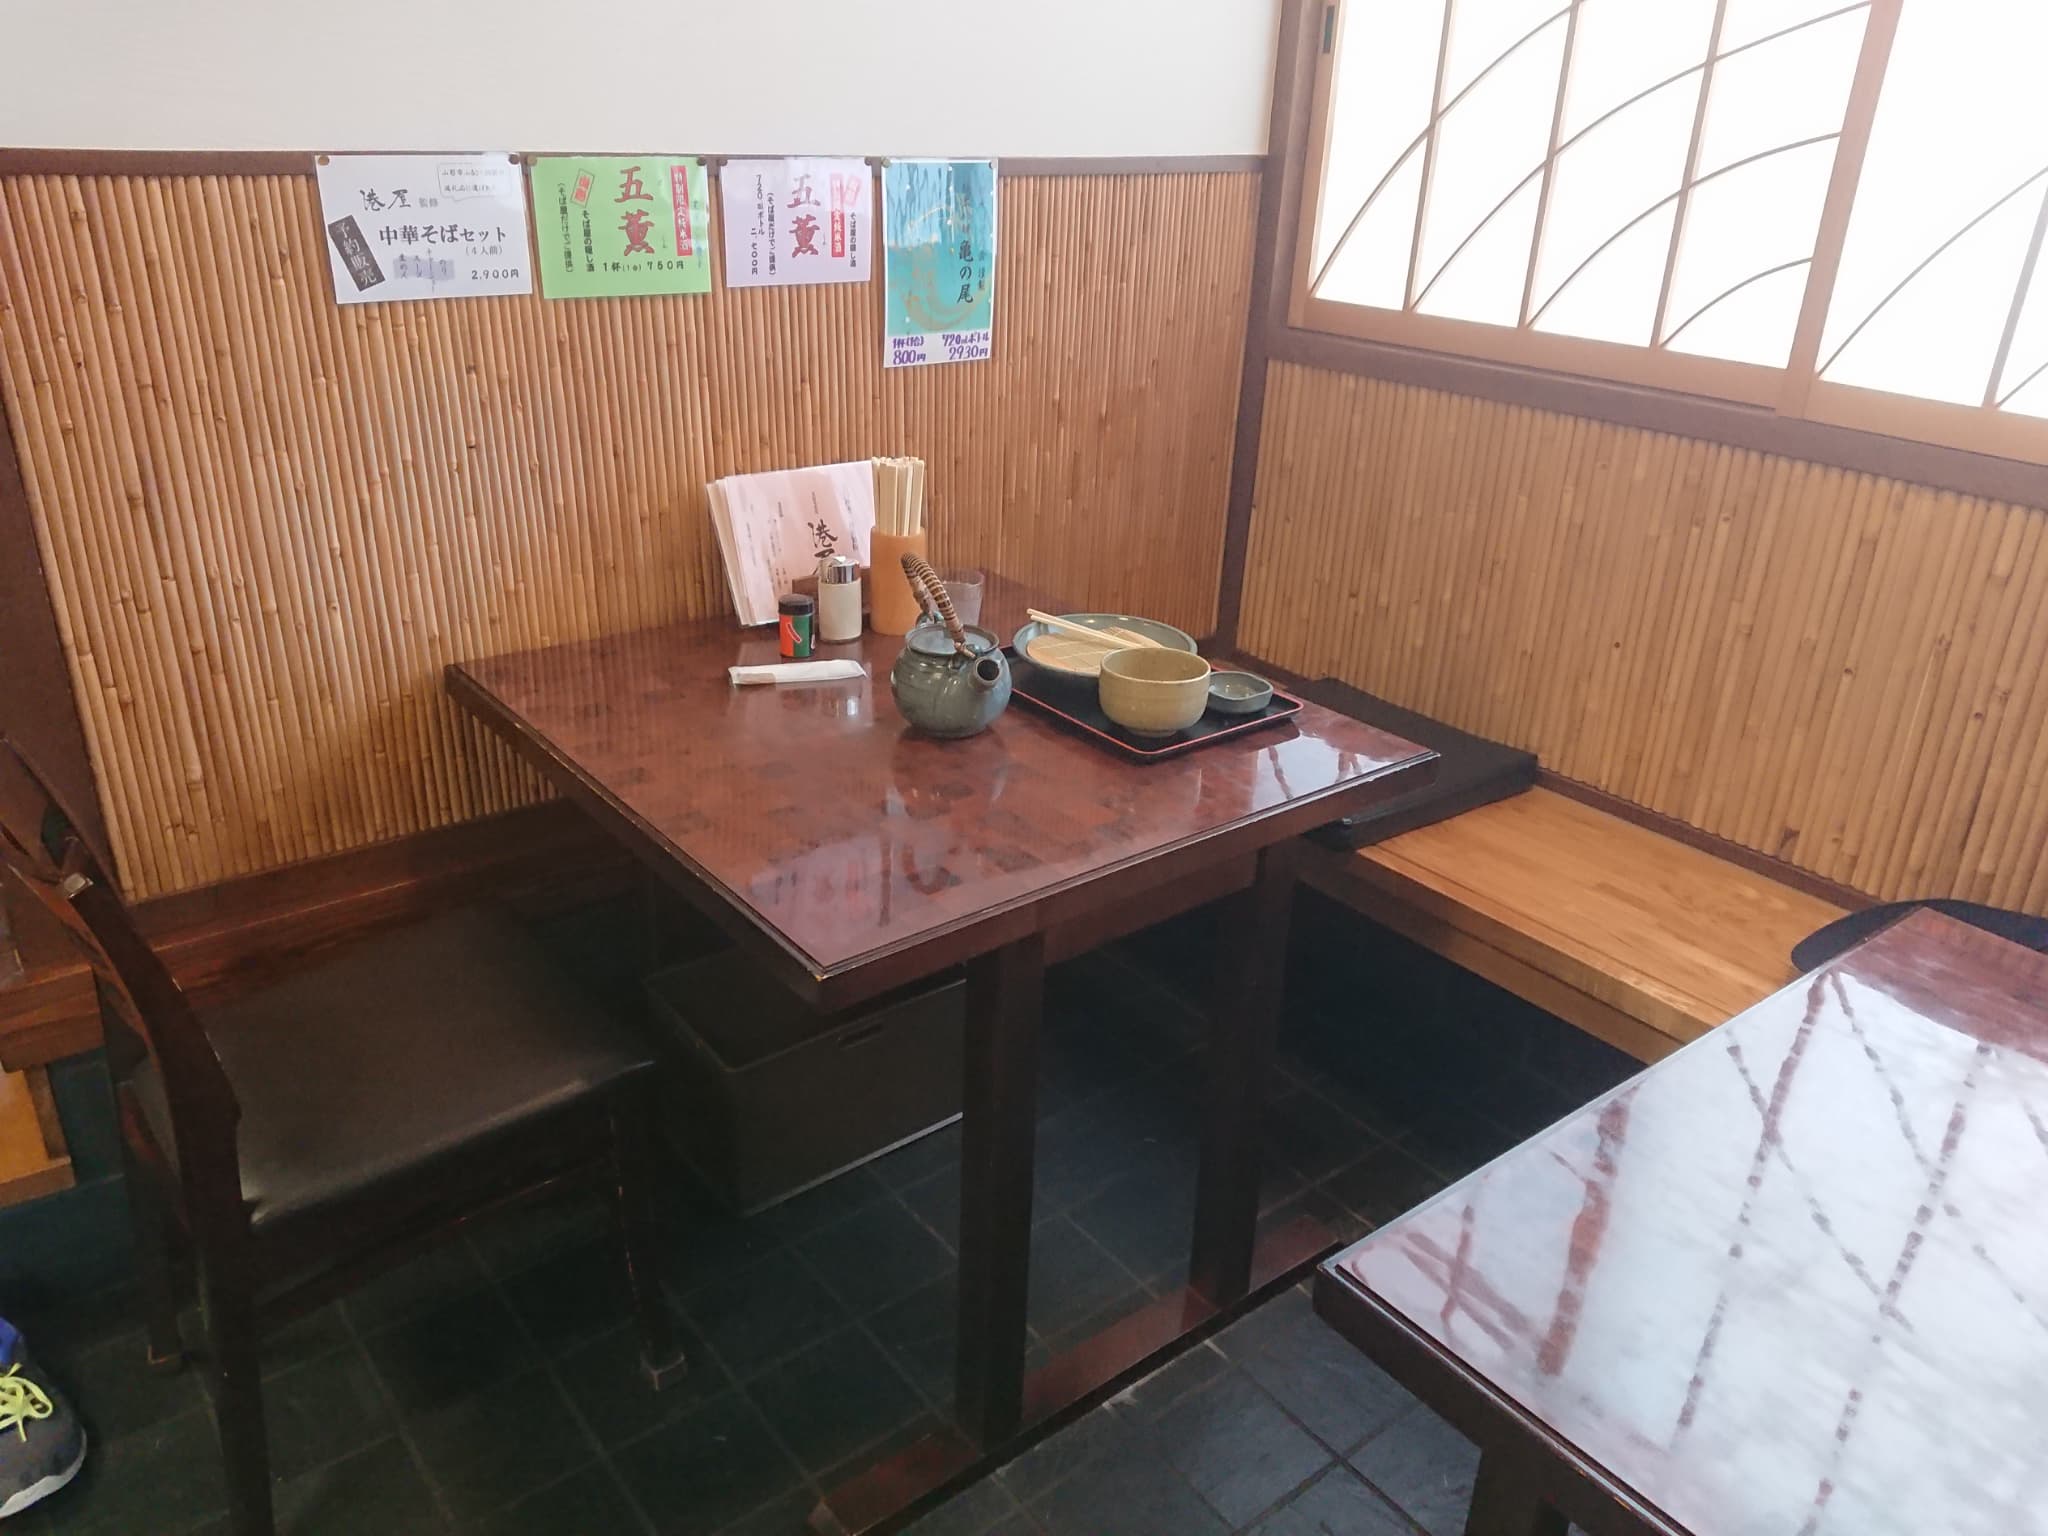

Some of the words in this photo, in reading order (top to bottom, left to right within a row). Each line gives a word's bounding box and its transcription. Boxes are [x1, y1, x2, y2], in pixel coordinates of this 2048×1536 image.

[379, 223, 507, 246] 中華そばセット
[957, 240, 973, 304] 亀の尾
[893, 350, 926, 365] 800円
[949, 345, 988, 361] 2930円
